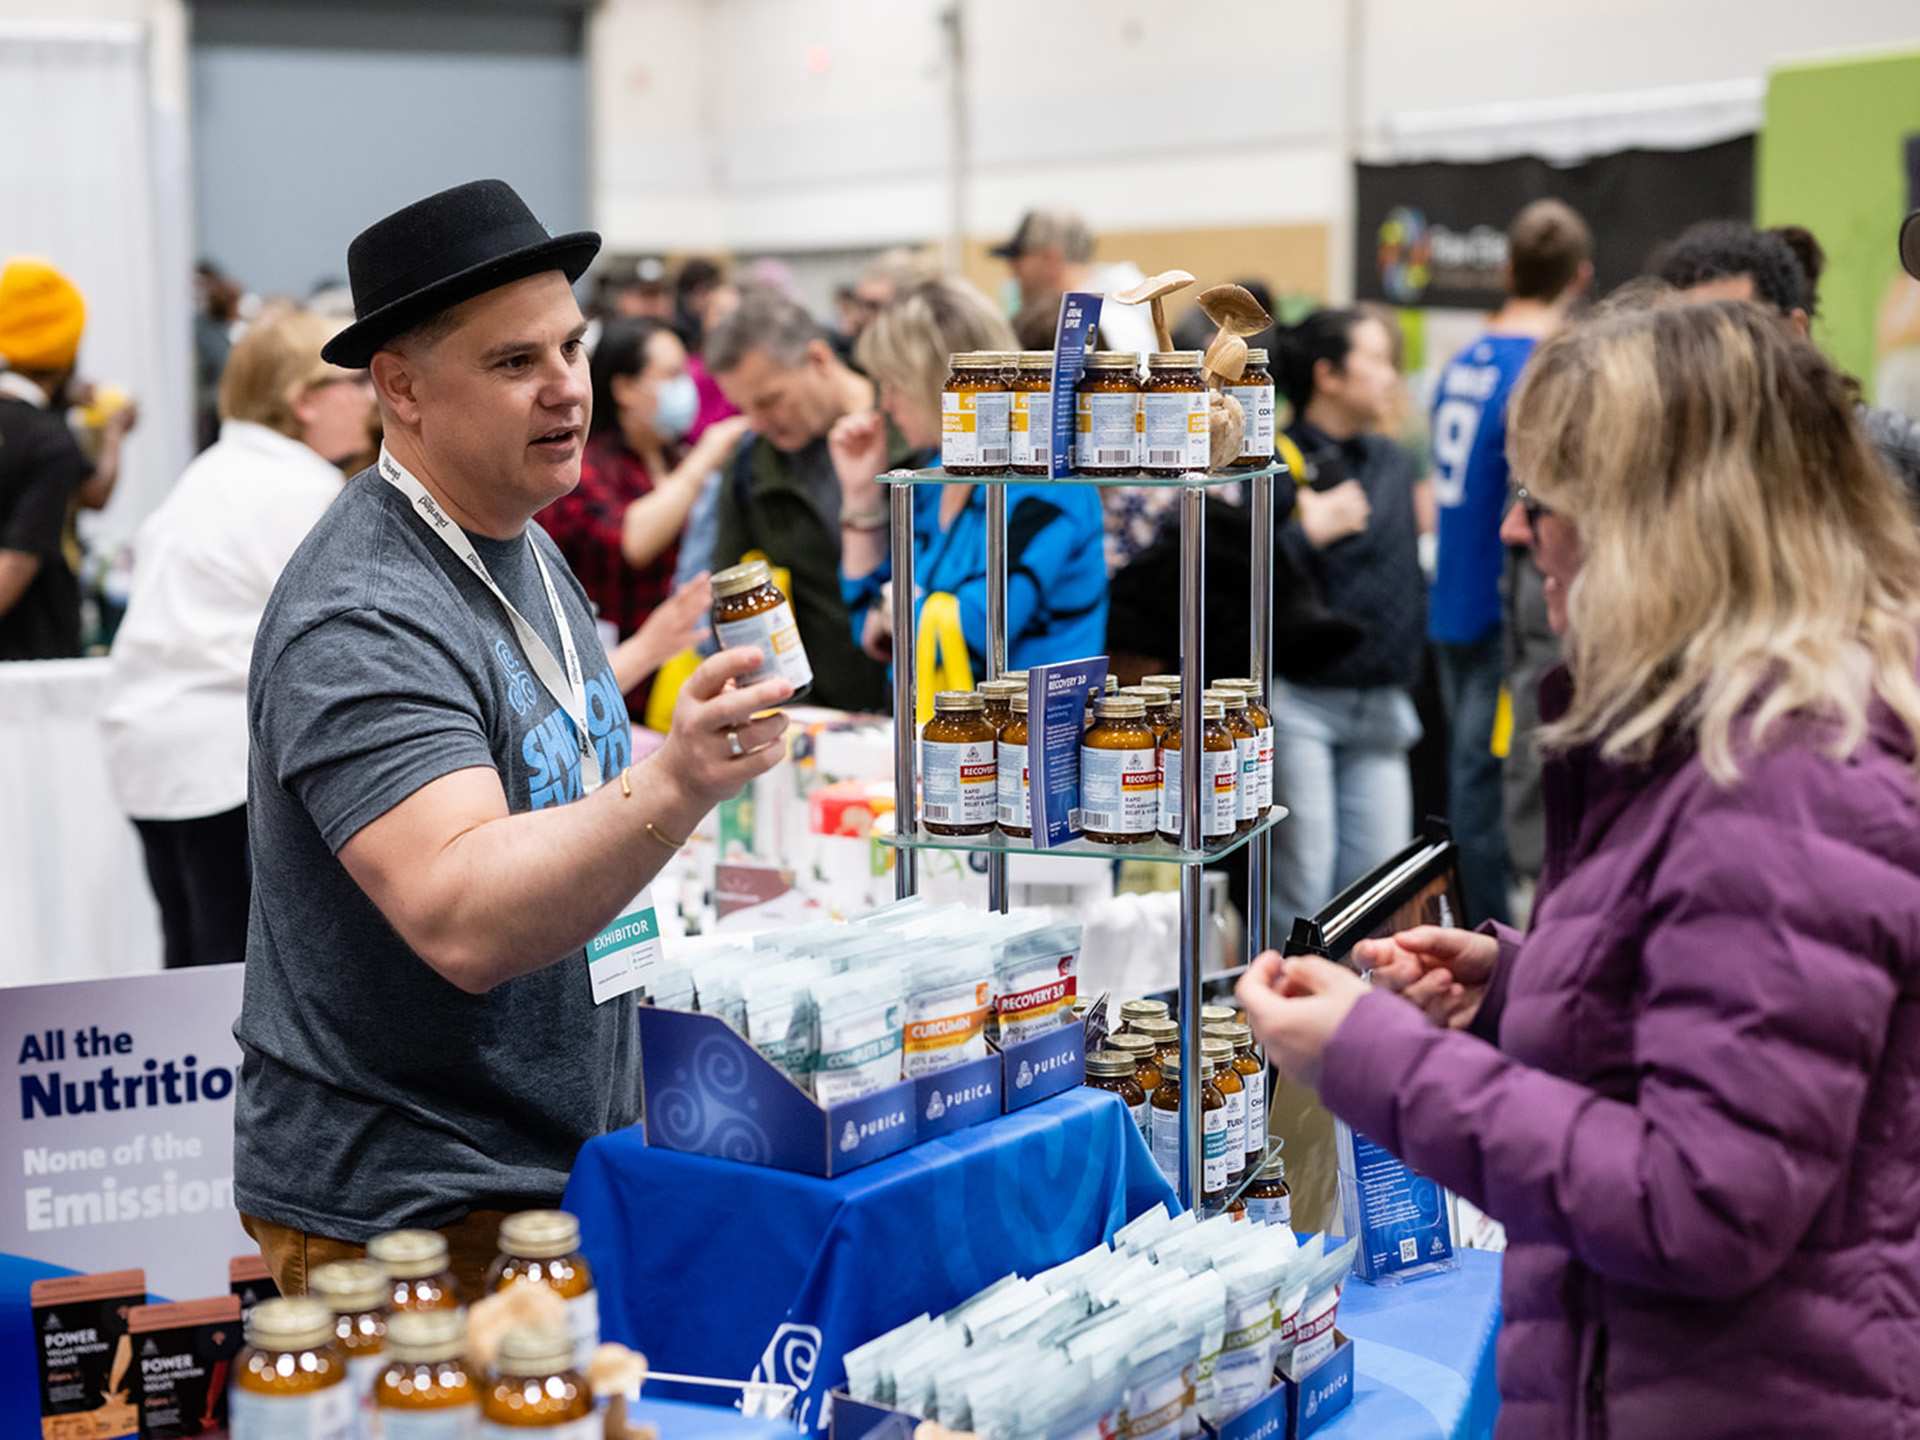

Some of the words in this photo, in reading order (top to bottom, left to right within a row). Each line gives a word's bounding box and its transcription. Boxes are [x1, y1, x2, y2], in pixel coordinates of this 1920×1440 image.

[593, 919, 650, 952] EXHIBITOR
[1001, 988, 1052, 1012] RECOVERY
[911, 1015, 971, 1039] CURCUMIN
[18, 1029, 66, 1065] All
[74, 1026, 134, 1059] the
[1034, 1050, 1077, 1076] PURICA
[19, 1055, 240, 1120] Nutritio
[946, 1083, 993, 1108] PURICA
[860, 1110, 906, 1138] PURICA
[23, 1147, 107, 1176] None
[113, 1134, 147, 1166] of
[151, 1132, 204, 1162] the
[44, 1328, 98, 1349] POWER
[141, 1354, 194, 1374] POWER
